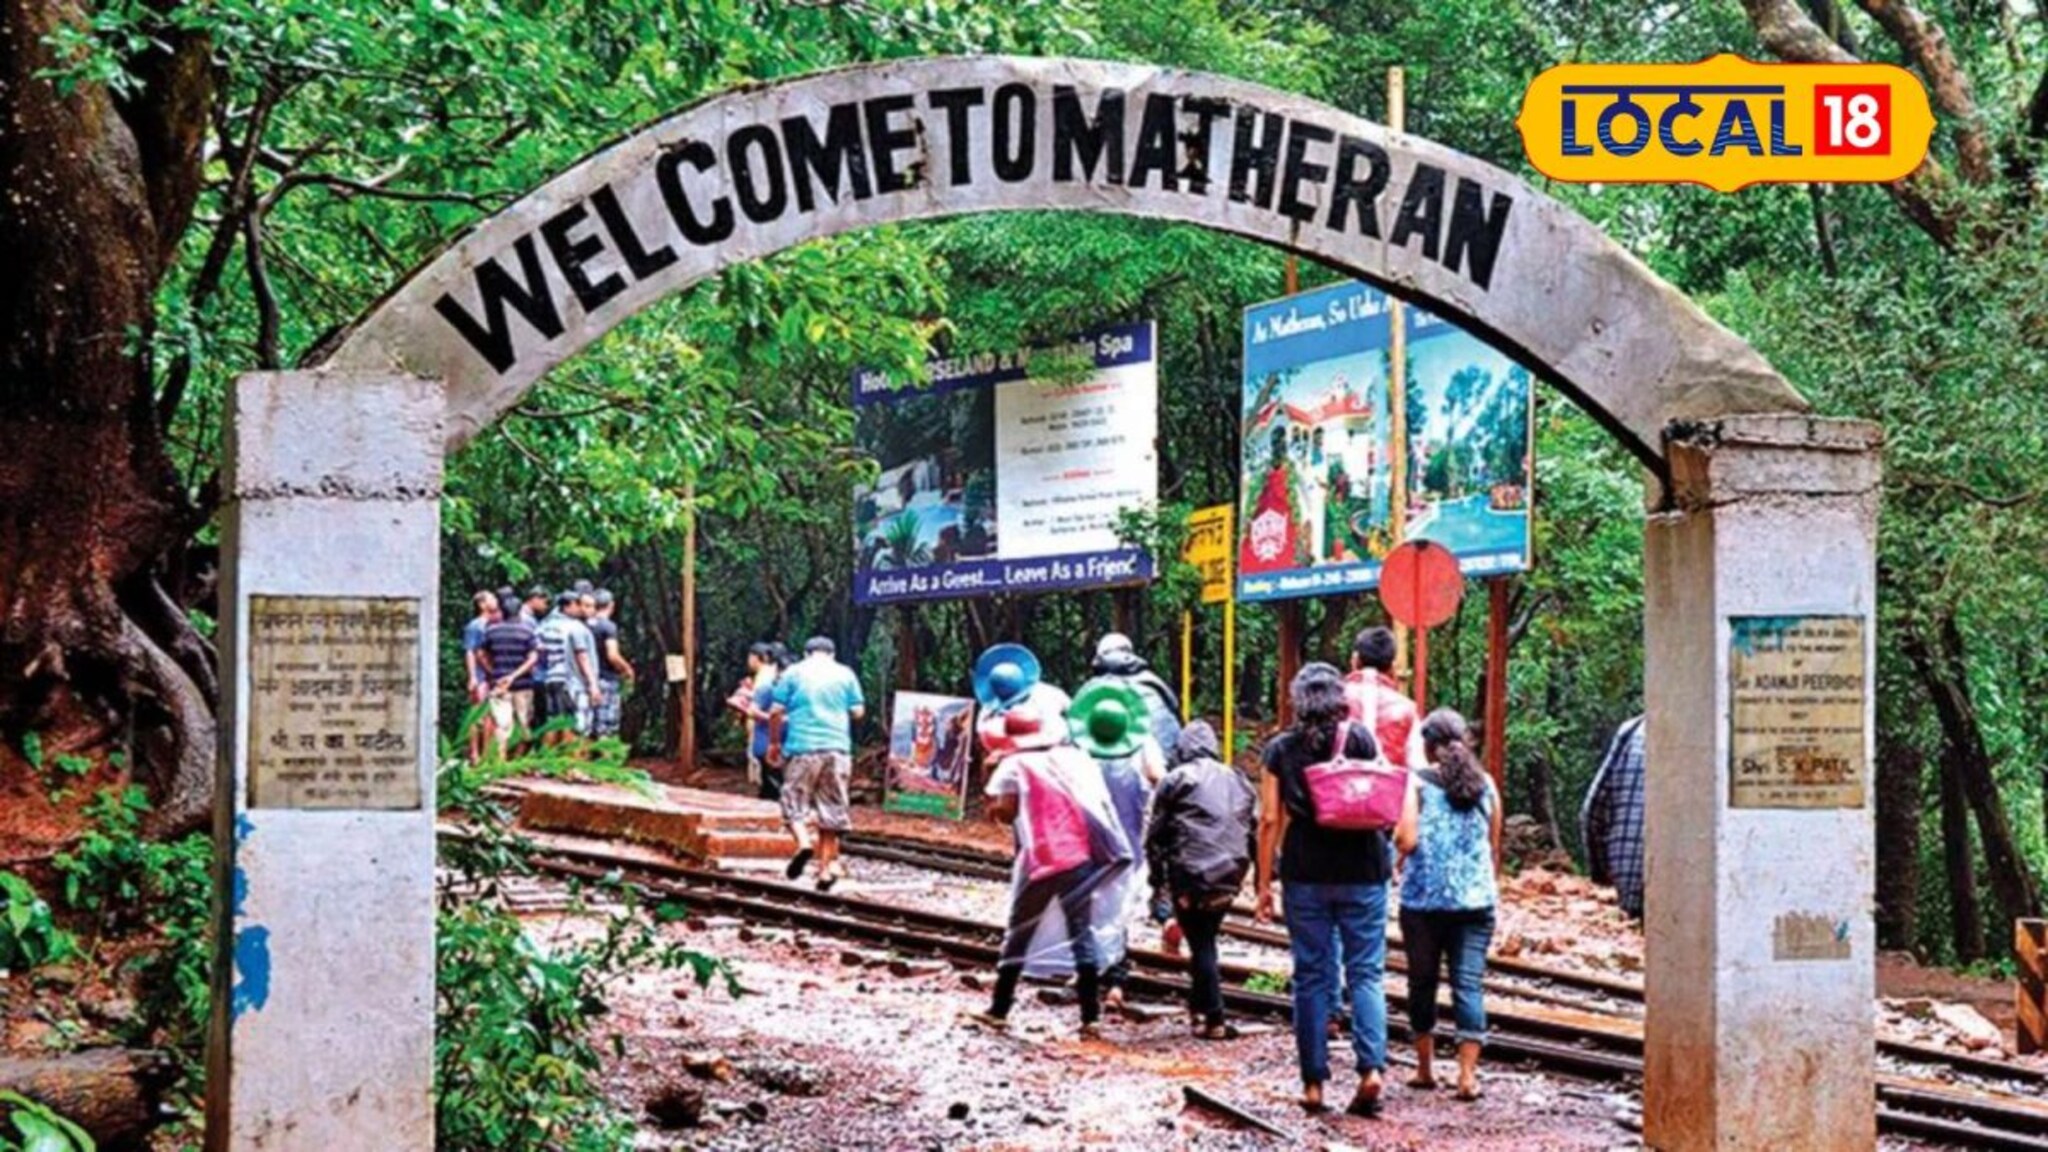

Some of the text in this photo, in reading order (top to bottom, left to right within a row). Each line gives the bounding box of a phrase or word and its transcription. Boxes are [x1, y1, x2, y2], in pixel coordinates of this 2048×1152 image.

[434, 82, 1513, 375] WELCOME TO MATHERAN
[1099, 333, 1134, 360] Spa
[868, 575, 908, 597] Arrive
[909, 574, 928, 594] As
[930, 577, 940, 591] a
[1004, 561, 1048, 582] Leave
[1051, 559, 1071, 580] As
[1074, 562, 1086, 578] a
